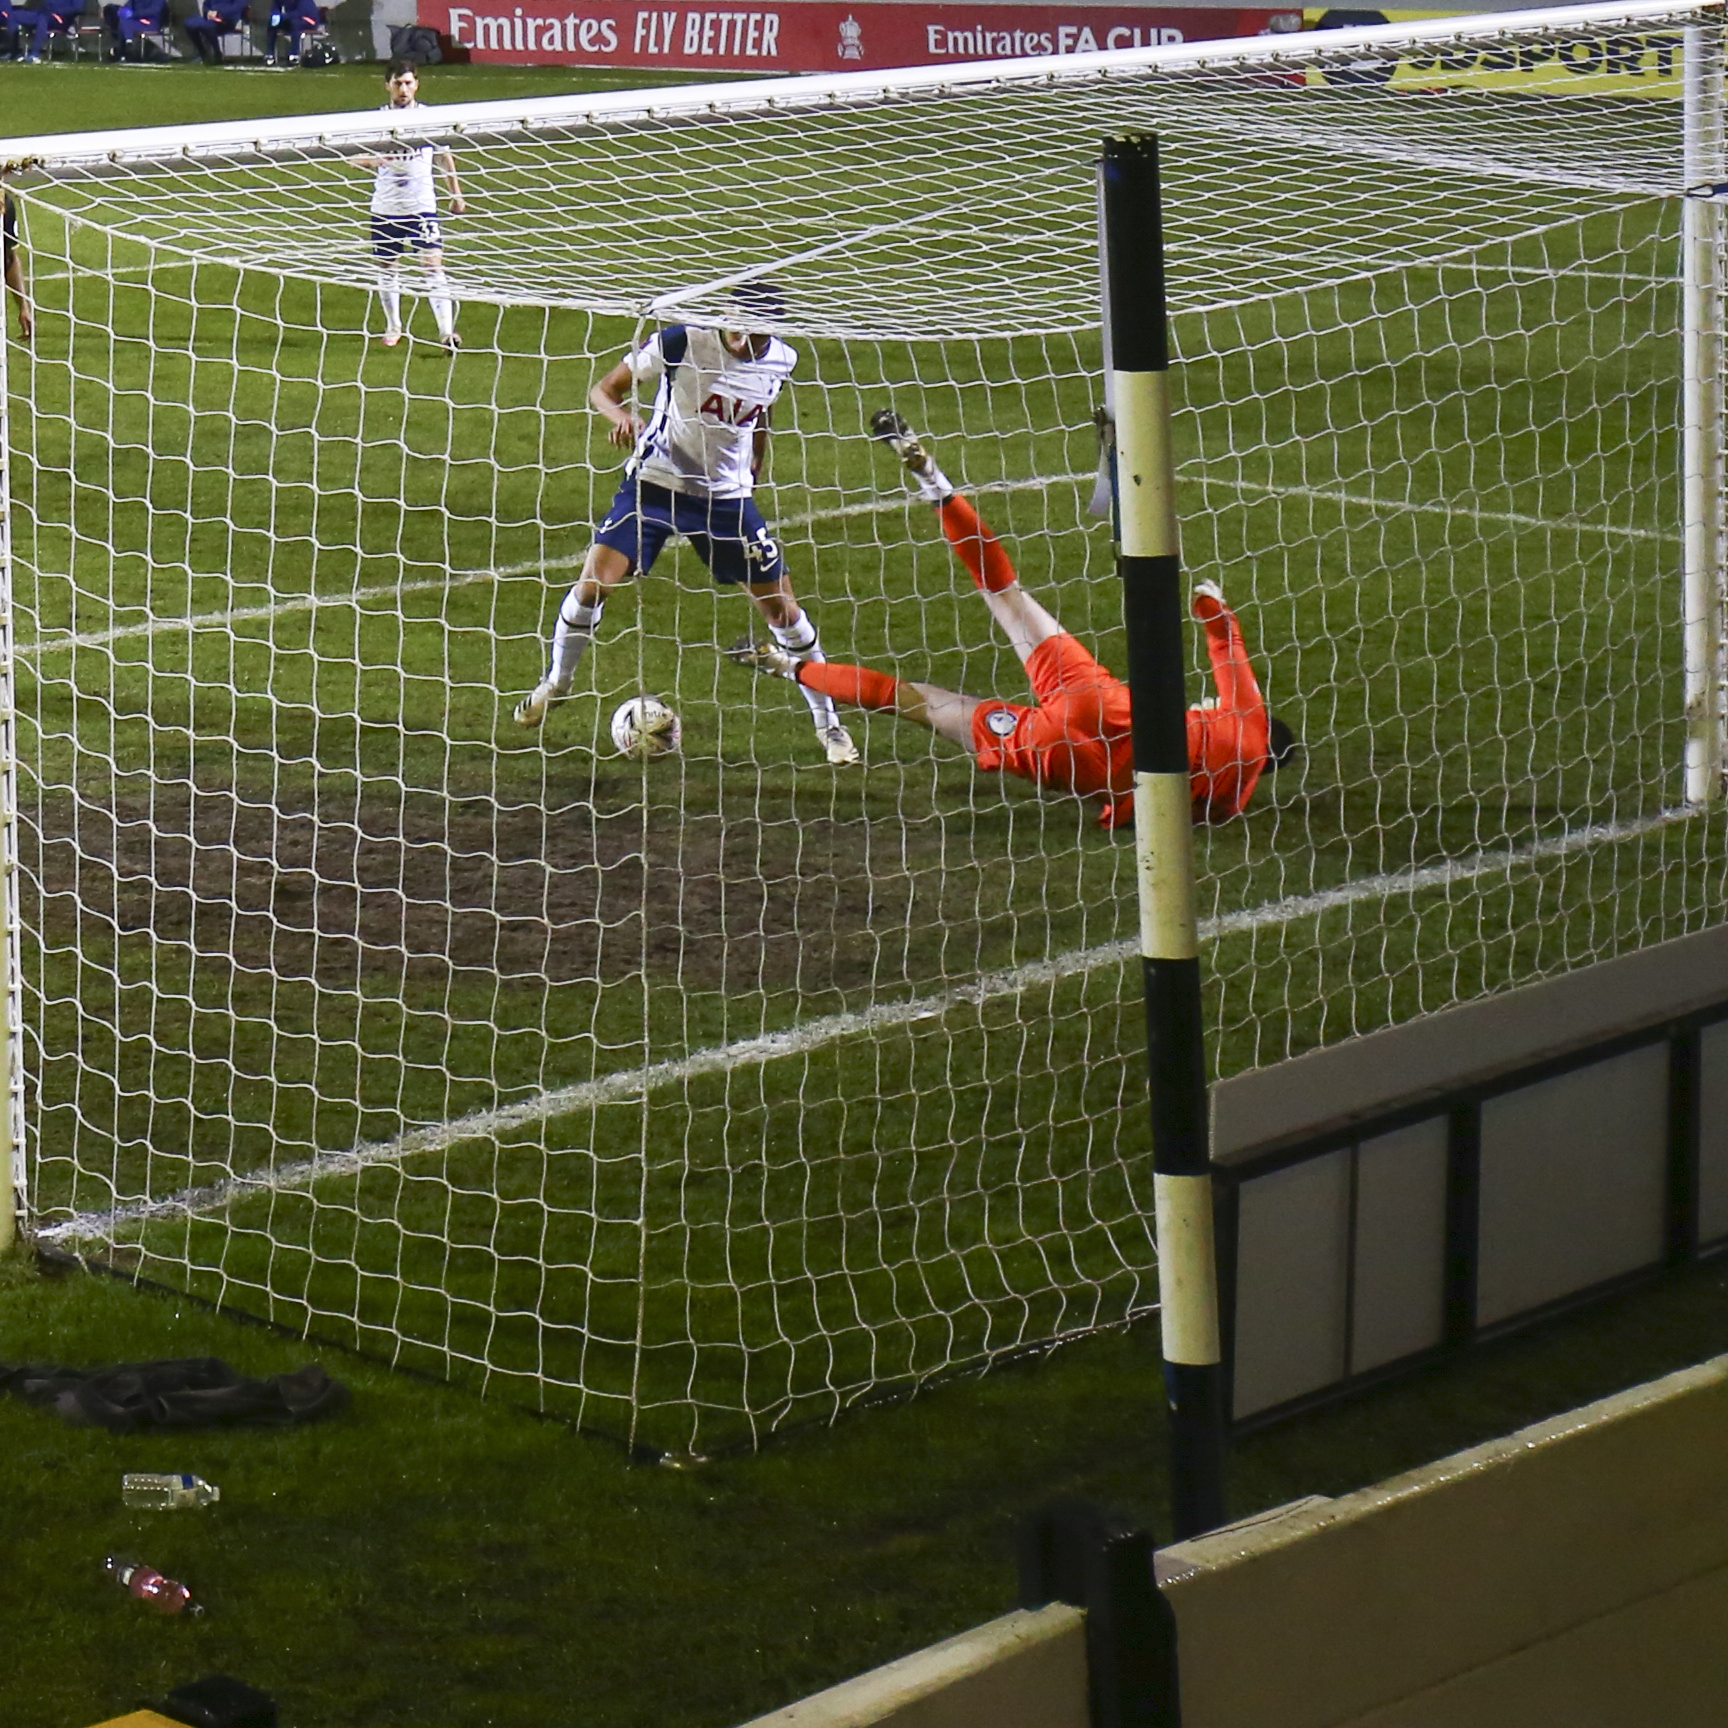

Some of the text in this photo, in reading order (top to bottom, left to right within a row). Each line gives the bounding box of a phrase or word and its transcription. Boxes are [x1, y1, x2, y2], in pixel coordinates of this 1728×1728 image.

[448, 7, 780, 57] Emirates FLY BETTER
[926, 24, 1053, 56] Emirates
[1057, 25, 1100, 56] FA
[418, 221, 441, 243] 33
[695, 393, 764, 427] AIA
